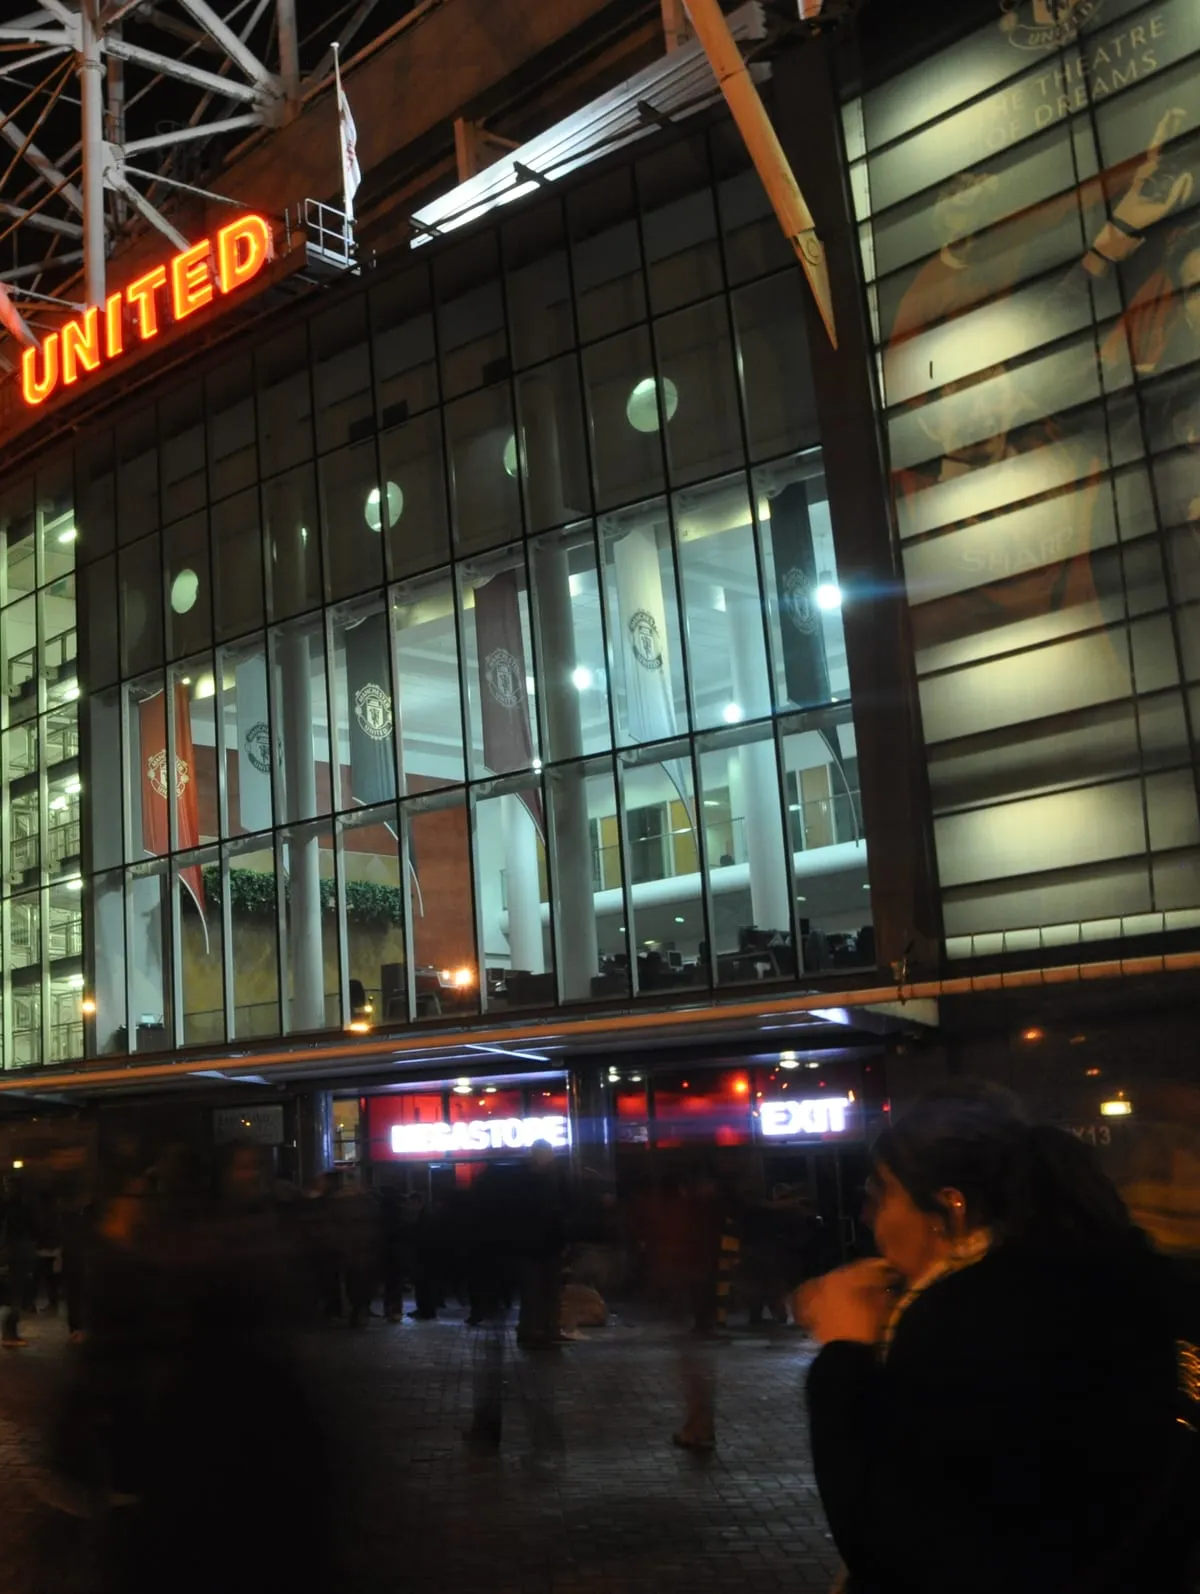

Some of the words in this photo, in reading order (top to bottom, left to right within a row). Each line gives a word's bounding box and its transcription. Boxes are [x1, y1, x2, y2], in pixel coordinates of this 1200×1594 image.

[1035, 50, 1158, 129] DREAMS
[1036, 15, 1165, 97] THEATRE
[21, 213, 274, 406] UNITED
[959, 526, 1074, 574] SHARP
[760, 1097, 848, 1135] EXIT
